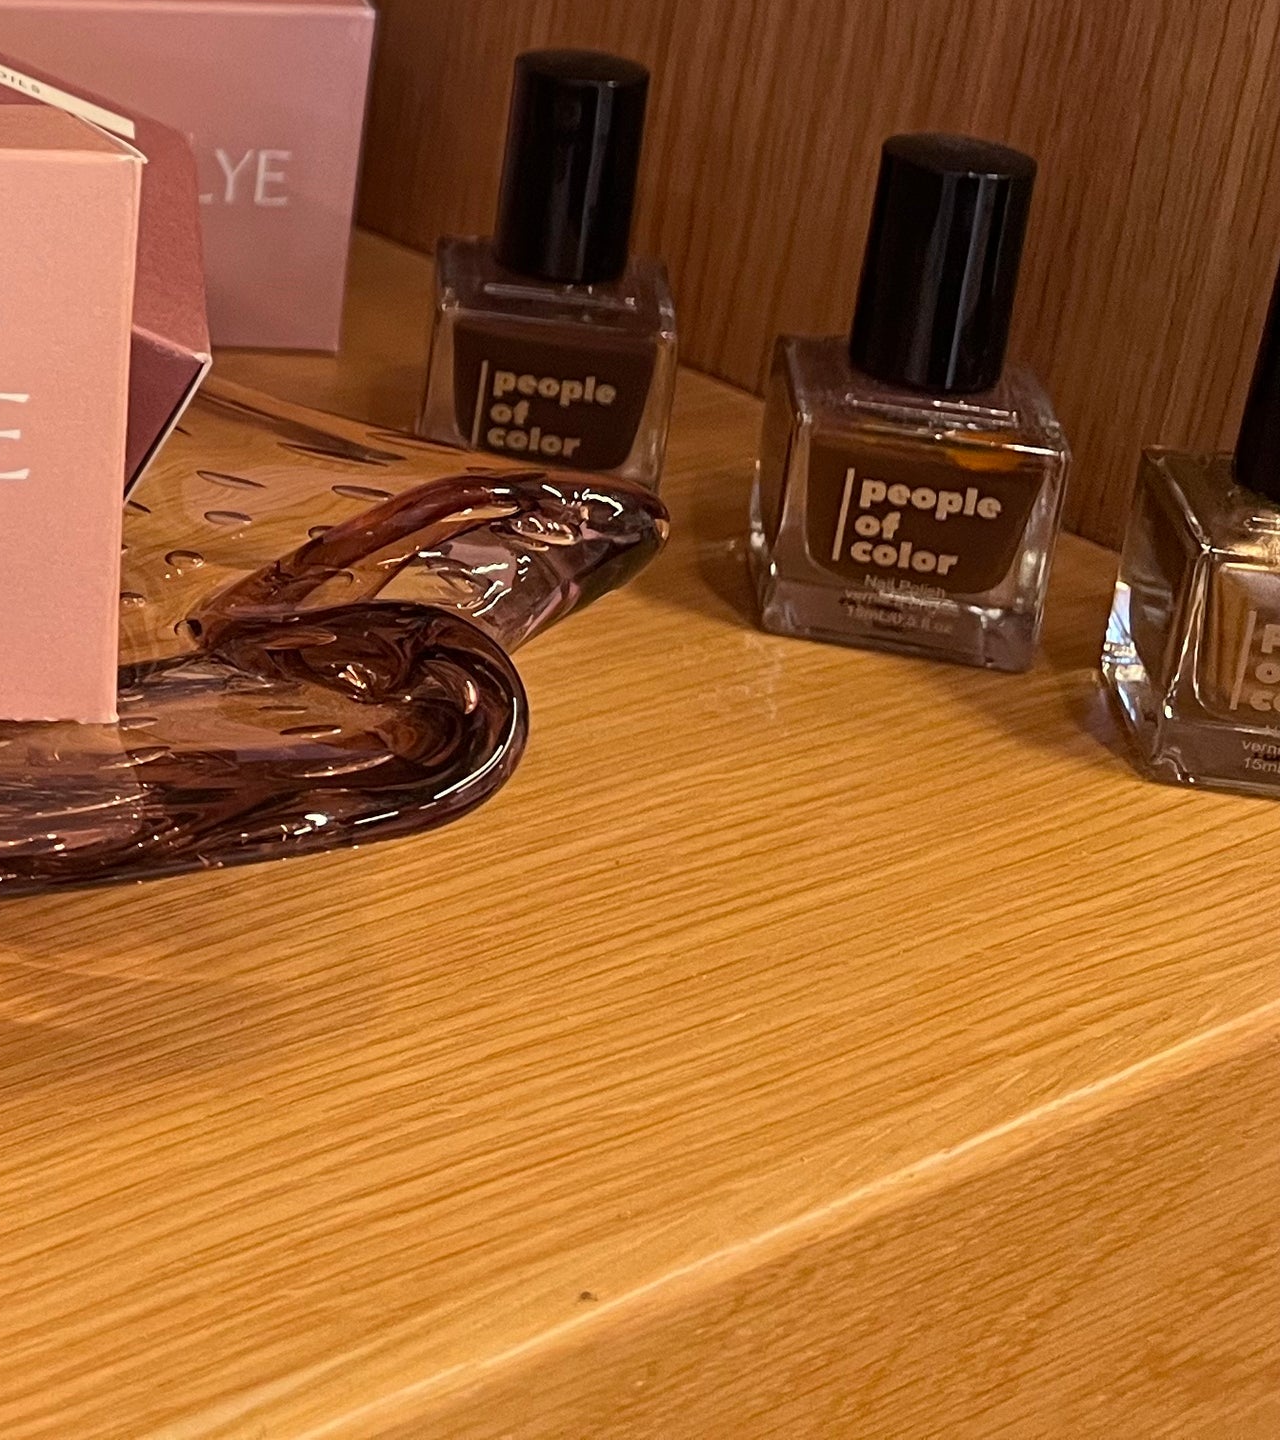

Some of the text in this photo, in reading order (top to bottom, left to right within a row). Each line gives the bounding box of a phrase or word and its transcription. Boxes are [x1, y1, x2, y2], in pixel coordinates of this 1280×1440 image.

[493, 370, 617, 407] people
[490, 399, 530, 425] of
[487, 427, 582, 457] color
[858, 478, 1002, 521] people
[854, 511, 901, 540] of
[850, 540, 959, 576] color
